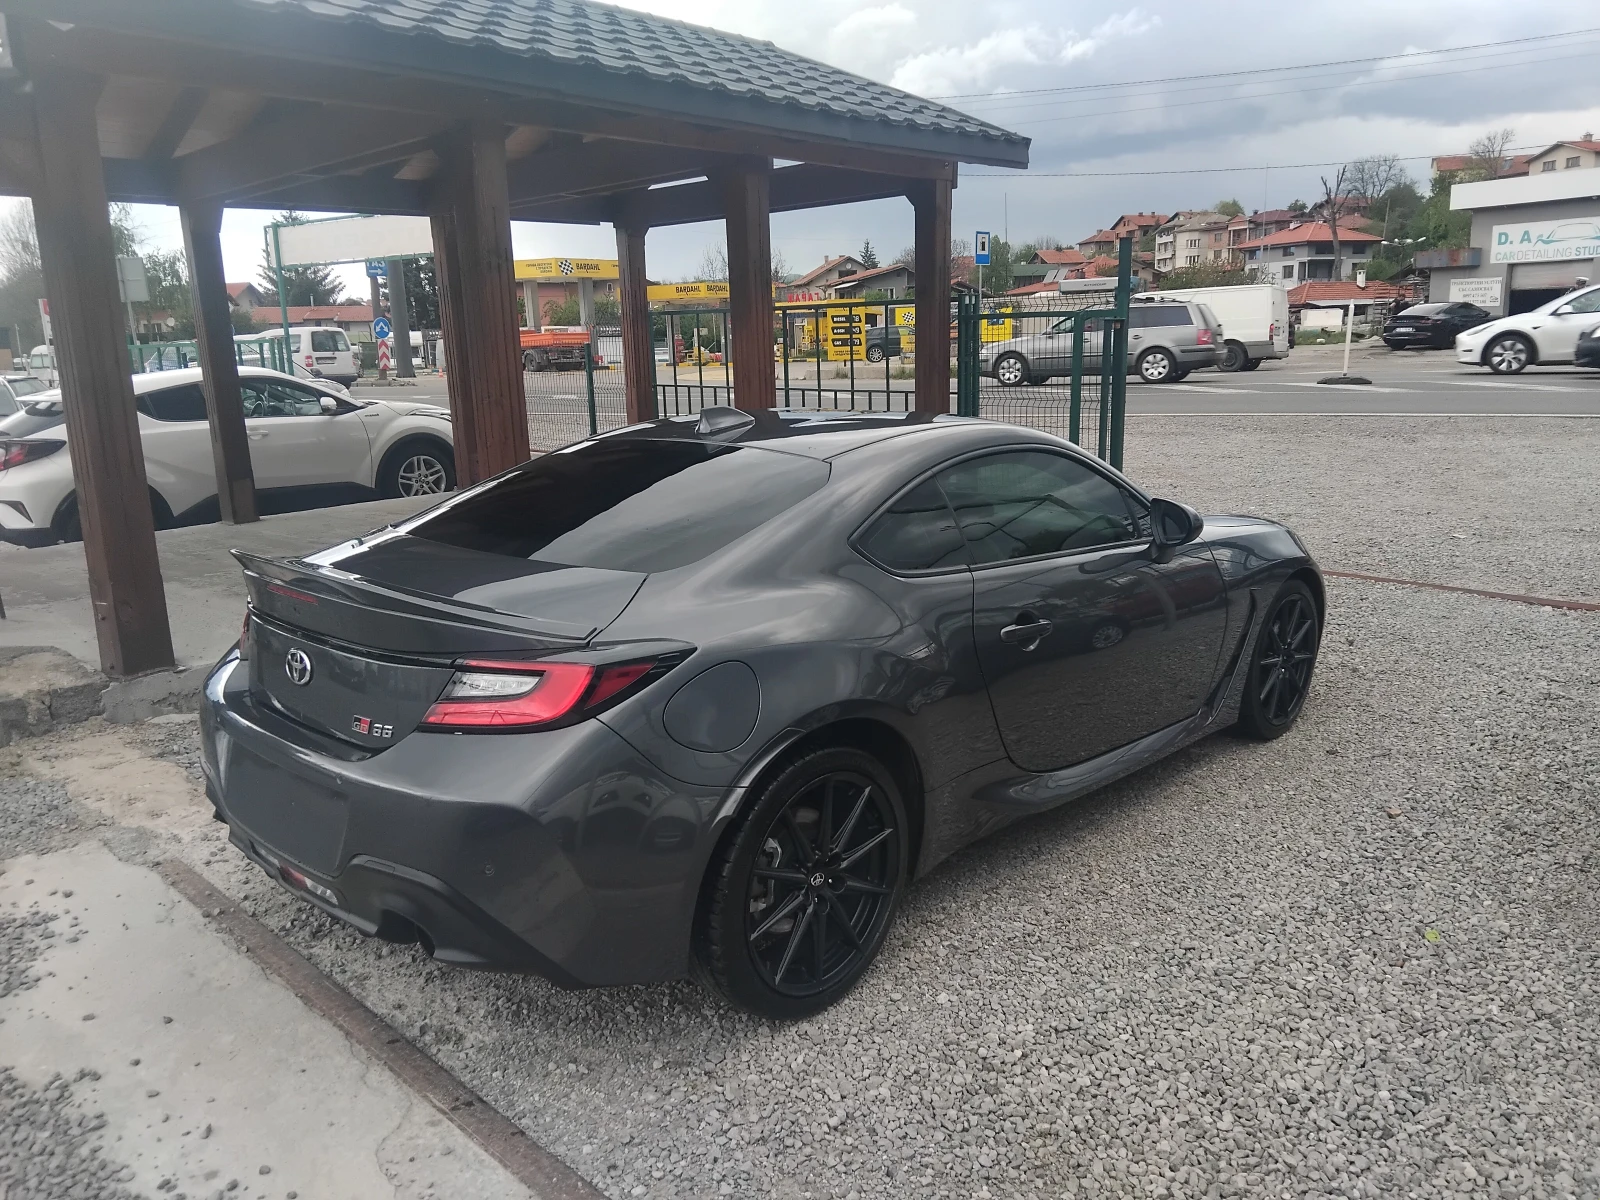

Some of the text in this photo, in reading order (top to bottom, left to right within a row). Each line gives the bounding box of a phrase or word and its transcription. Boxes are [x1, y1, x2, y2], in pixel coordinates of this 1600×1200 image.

[1519, 230, 1532, 244] A
[576, 263, 601, 273] BARDAHL
[676, 285, 701, 295] BARDAHL
[706, 284, 728, 294] BARDAHL
